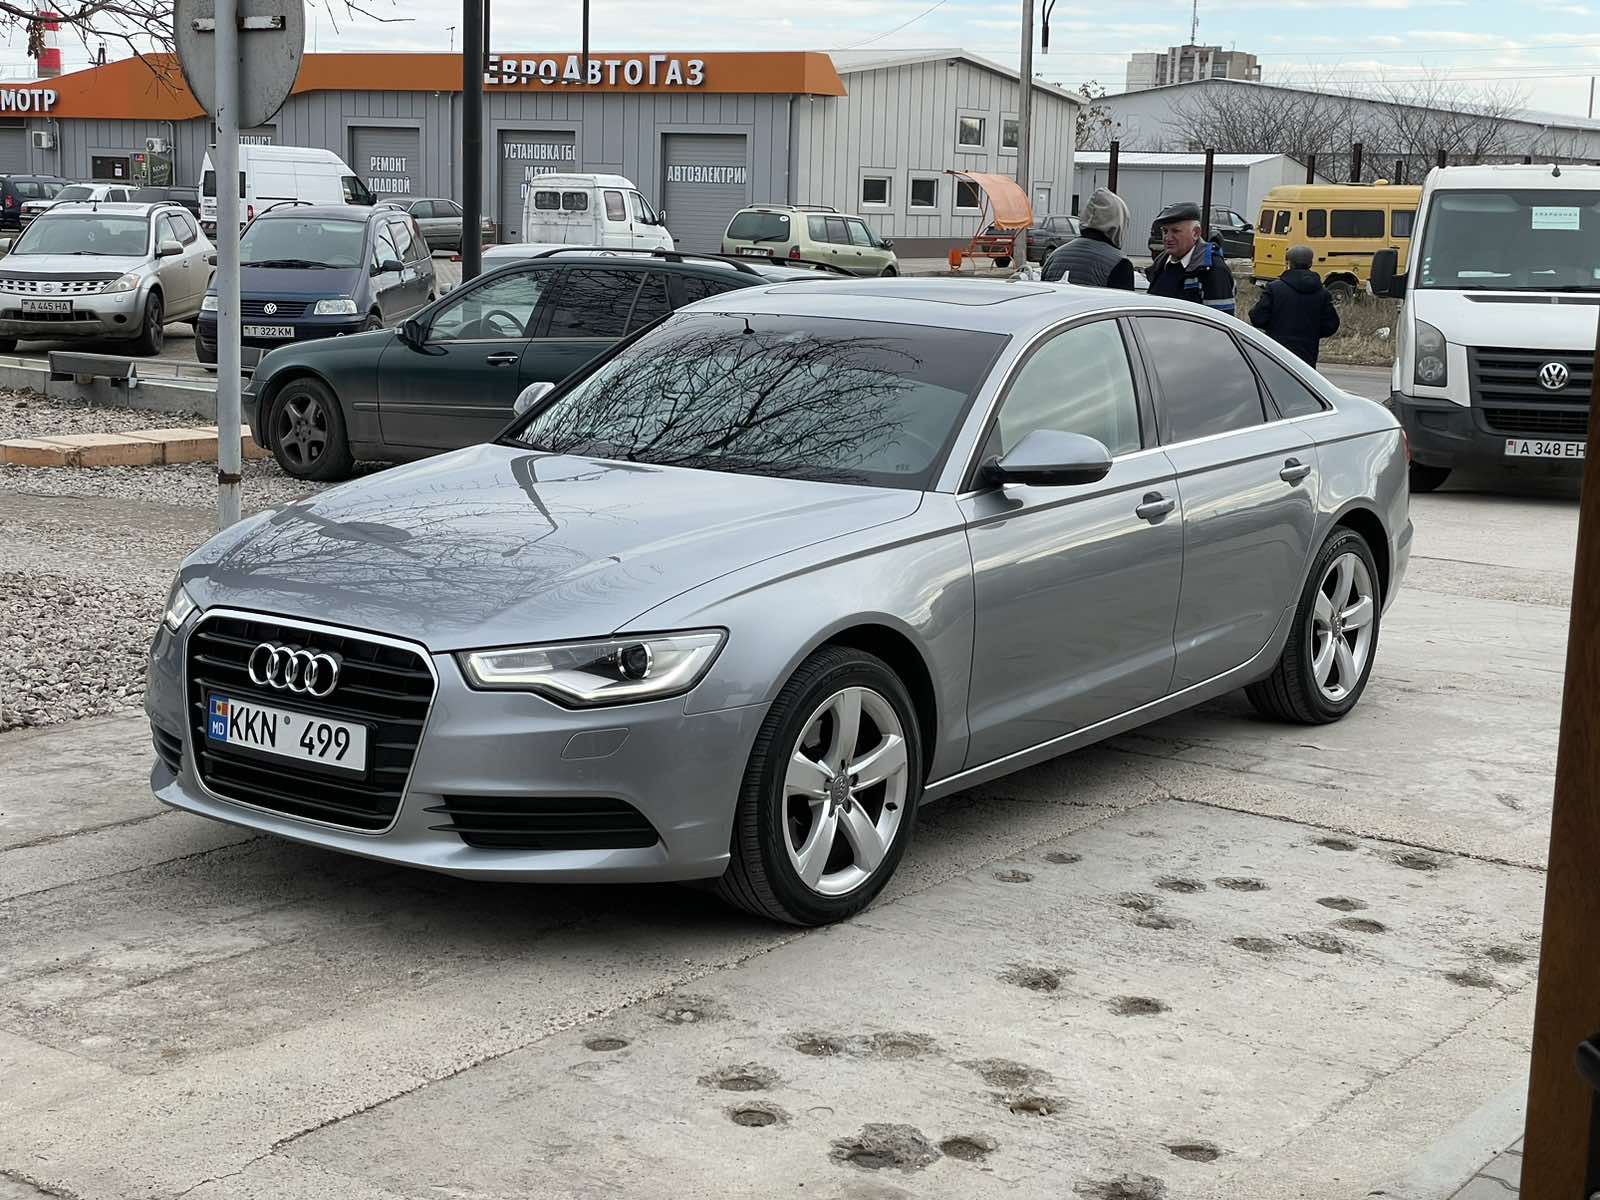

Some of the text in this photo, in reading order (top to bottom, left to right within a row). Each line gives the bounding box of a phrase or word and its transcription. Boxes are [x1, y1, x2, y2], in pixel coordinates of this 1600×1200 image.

[0, 88, 57, 112] МОТР
[504, 143, 560, 160] УСТАНОВКА
[370, 156, 407, 172] РЕМОНТ
[368, 176, 410, 193] ХОДОВОЙ
[260, 327, 277, 336] 322
[278, 327, 292, 337] KM
[1520, 441, 1586, 457] A 348 EH
[212, 720, 225, 736] MD
[229, 704, 350, 761] KKN 499
